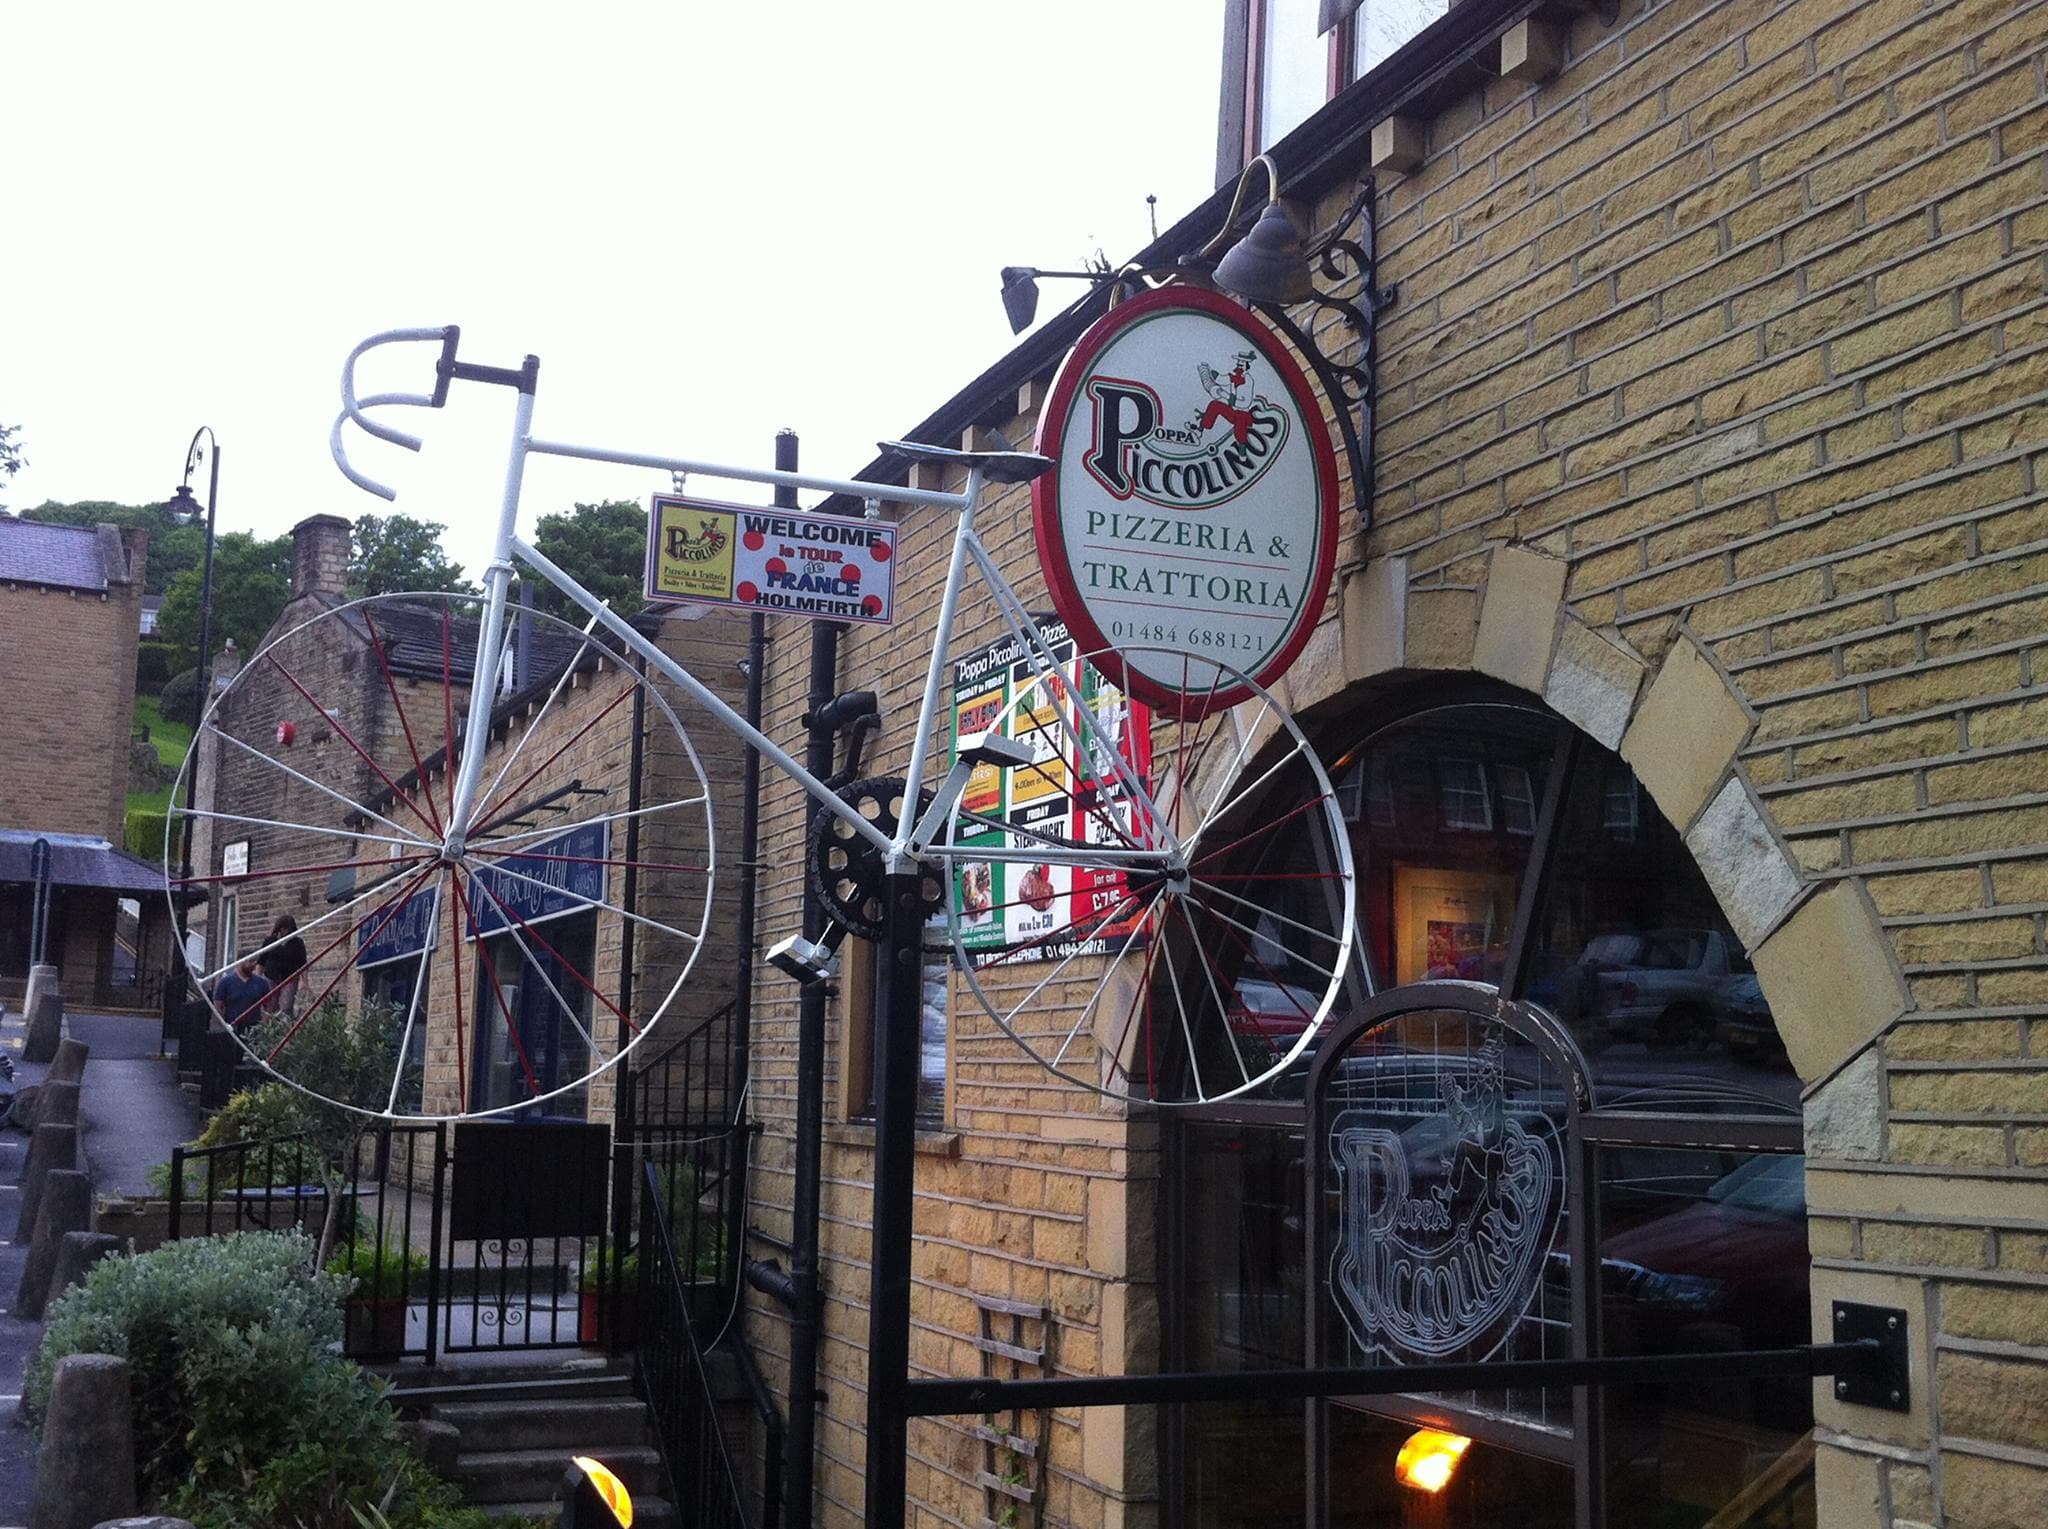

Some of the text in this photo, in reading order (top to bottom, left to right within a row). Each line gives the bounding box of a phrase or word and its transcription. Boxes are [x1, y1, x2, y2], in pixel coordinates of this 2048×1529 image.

[744, 515, 882, 548] WELCOME
[1086, 510, 1290, 558] PIZZERIA &
[798, 546, 844, 564] TOUR
[804, 561, 825, 574] de
[767, 571, 860, 598] FRANCE
[1082, 561, 1293, 608] TRATTORIA
[755, 592, 874, 617] HOLMFIRTH
[1112, 621, 1263, 651] 01484 688121
[959, 657, 988, 682] Poppa
